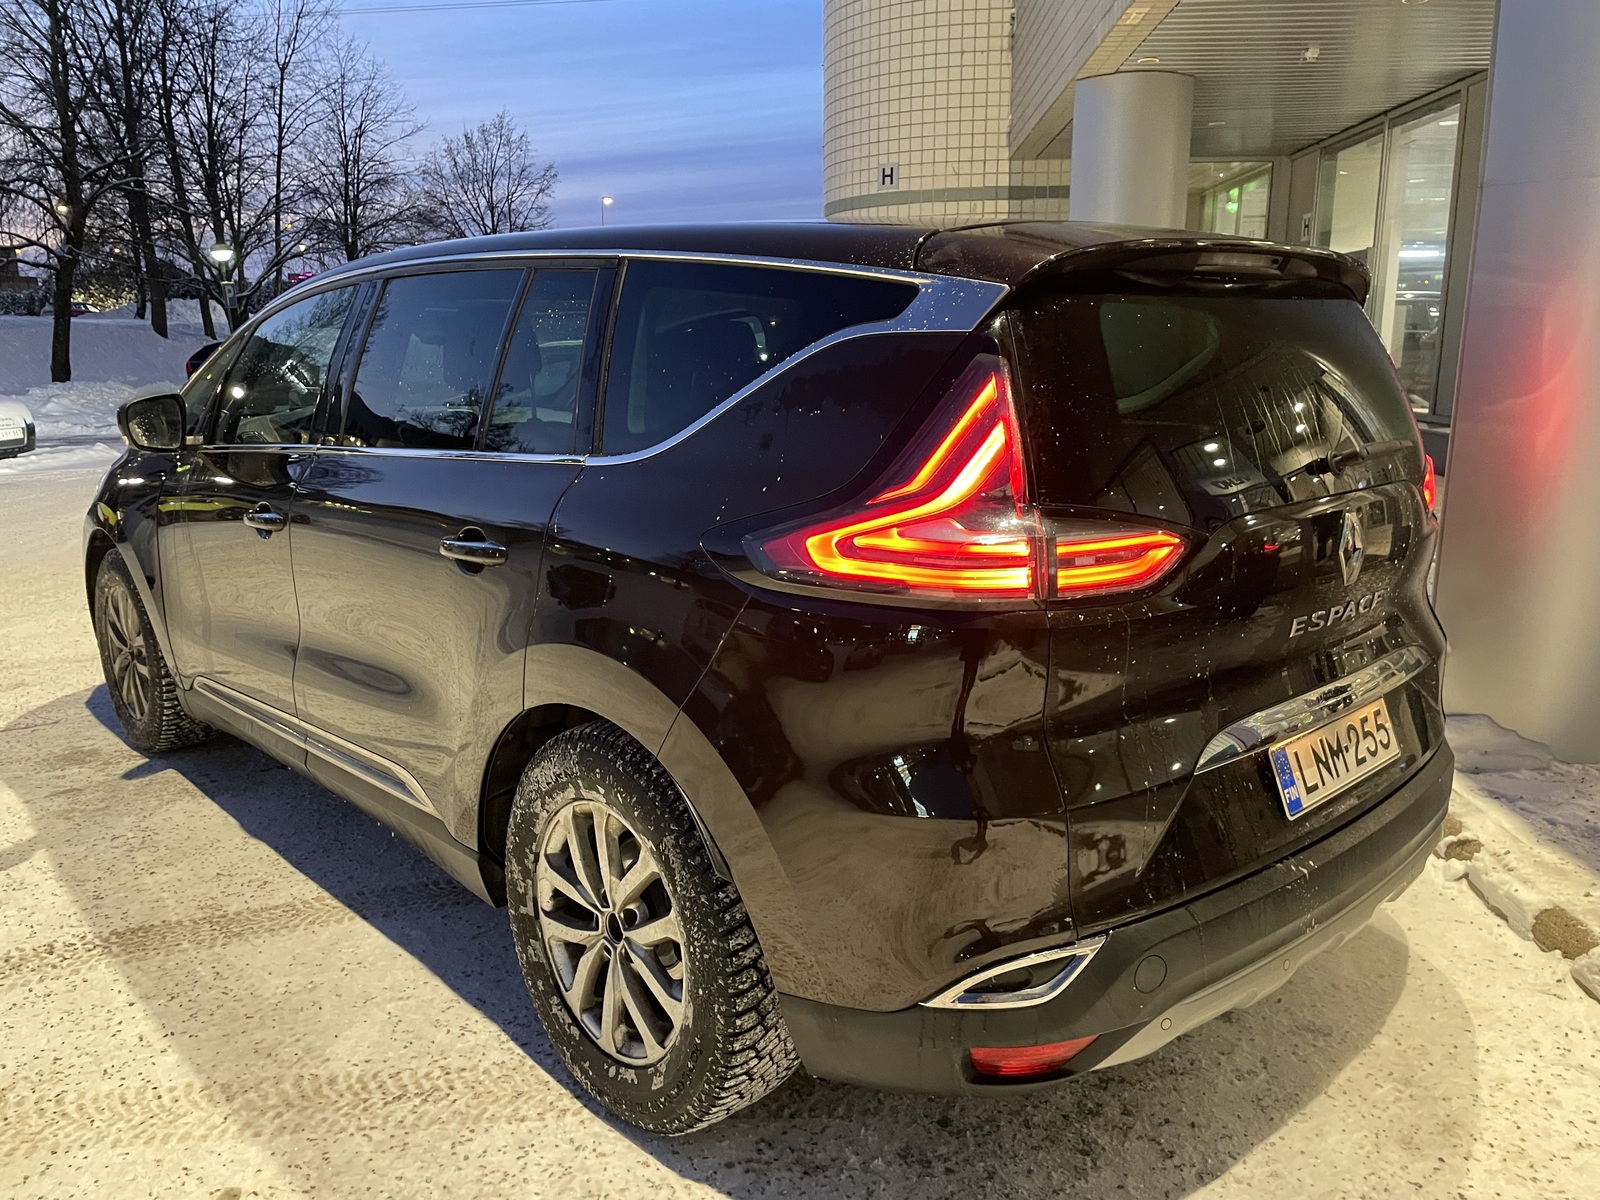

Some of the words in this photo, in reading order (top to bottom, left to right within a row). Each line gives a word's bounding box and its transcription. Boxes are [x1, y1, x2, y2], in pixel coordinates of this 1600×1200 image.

[881, 167, 894, 186] H
[1303, 217, 1311, 237] H
[224, 285, 234, 306] P
[1289, 590, 1386, 639] ESPACE
[1294, 707, 1391, 796] LNM-255
[1283, 787, 1300, 804] FIN
